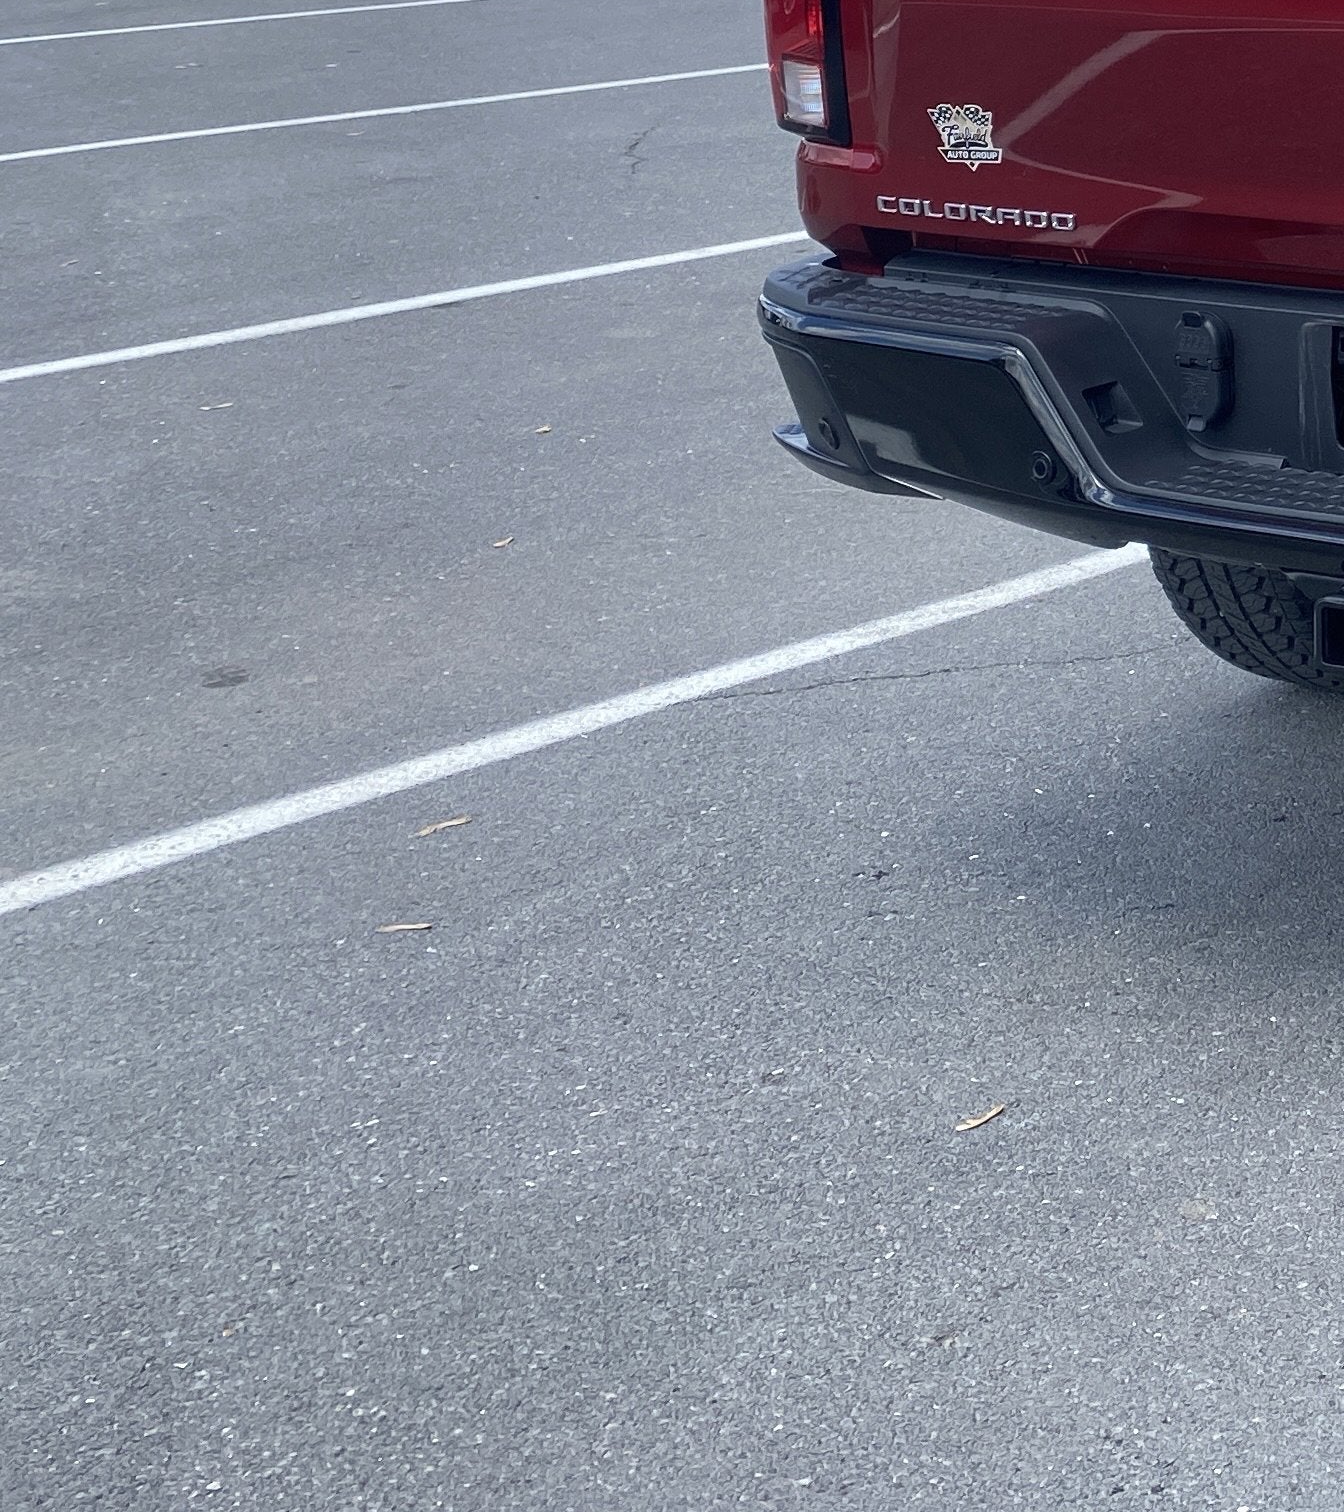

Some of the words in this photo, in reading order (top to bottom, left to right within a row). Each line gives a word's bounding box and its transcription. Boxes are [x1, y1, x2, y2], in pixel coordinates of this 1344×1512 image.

[947, 150, 969, 158] AUTO
[970, 150, 997, 160] GROUP
[876, 194, 1077, 231] COLORADO
